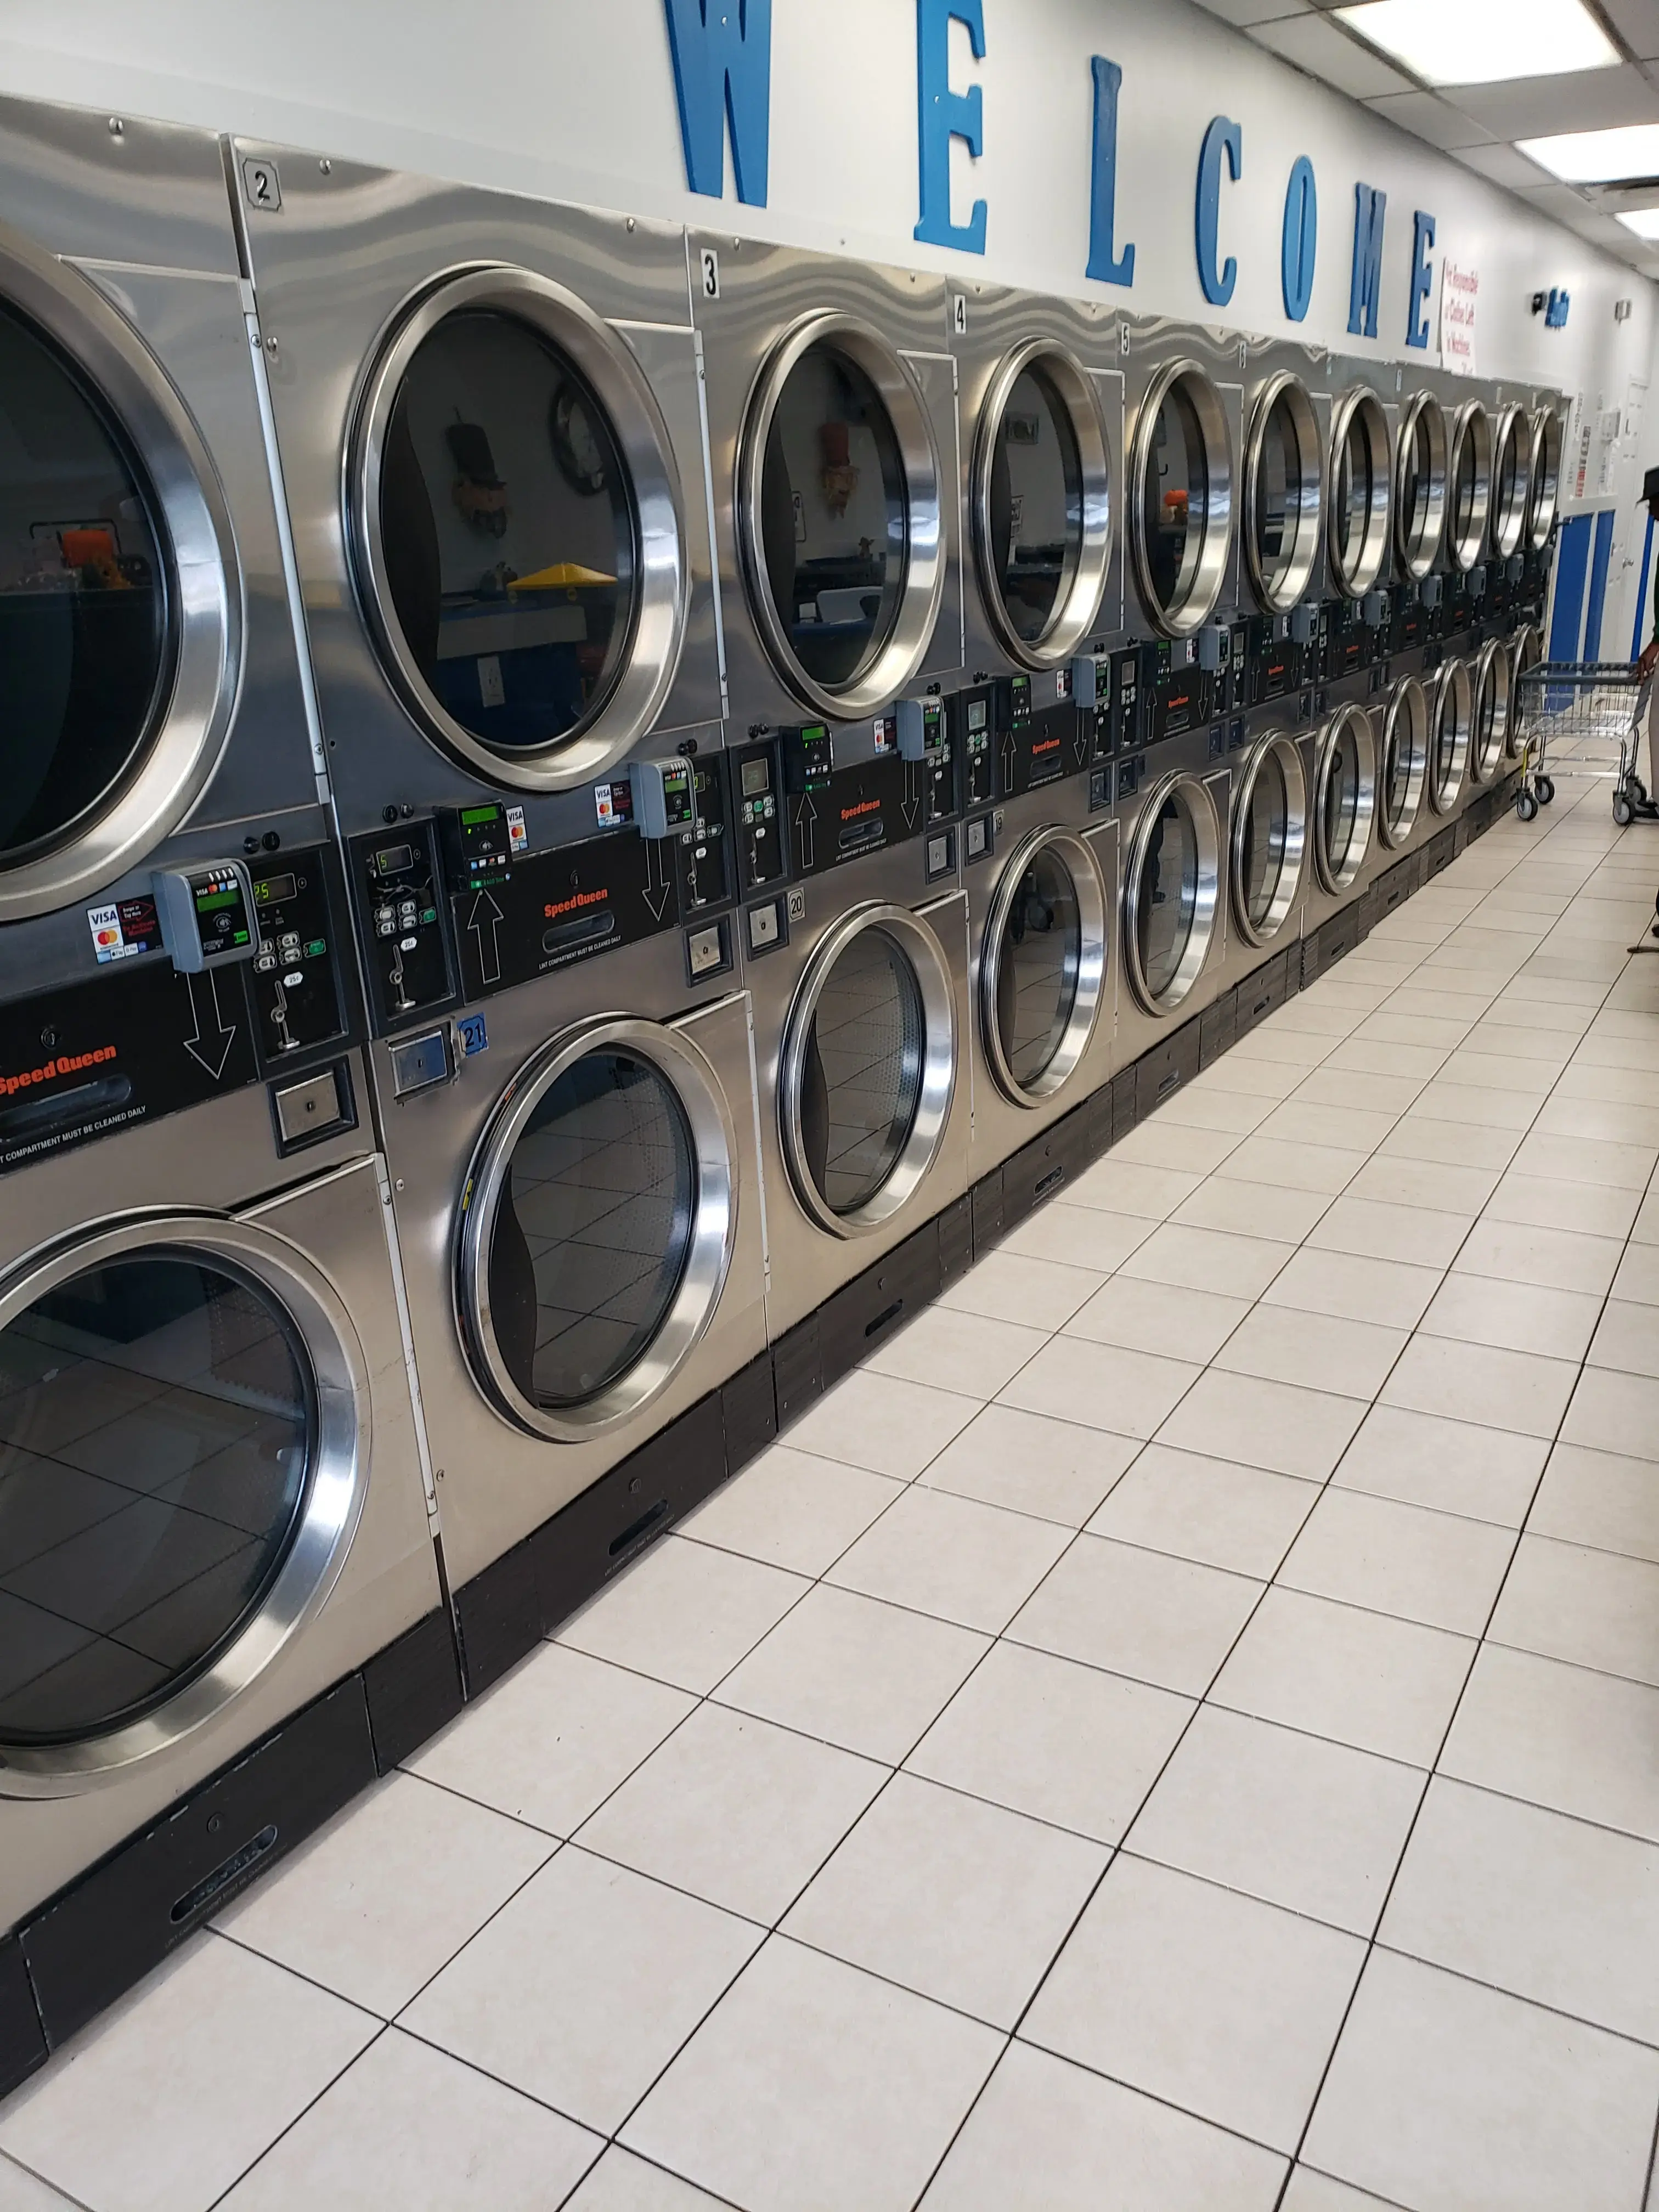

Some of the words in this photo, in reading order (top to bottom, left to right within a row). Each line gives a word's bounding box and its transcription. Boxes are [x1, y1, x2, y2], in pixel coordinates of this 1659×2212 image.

[255, 171, 270, 200] 2
[665, 0, 1435, 348] WELCOME
[704, 254, 716, 295] 3
[957, 300, 964, 330] 4
[1123, 325, 1128, 352] 5
[596, 790, 610, 799] VISA
[507, 811, 523, 822] VISA
[841, 804, 861, 820] Speed
[861, 799, 880, 812] Queen
[996, 817, 1002, 831] 19
[196, 888, 208, 896] VISA
[544, 896, 576, 918] Speed
[577, 889, 608, 906] Queen
[791, 896, 802, 915] 20
[92, 910, 117, 925] VISA
[539, 961, 548, 970] LINT
[549, 951, 577, 966] COMPARTMENT
[577, 946, 588, 956] MUST
[594, 939, 611, 950] CLEANED
[611, 935, 621, 944] DAILY
[464, 1023, 482, 1048] 21
[57, 1045, 117, 1074] Queen
[5, 1135, 61, 1162] COMPARTMENT
[62, 1128, 82, 1142] MUST
[83, 1124, 93, 1134] BE
[94, 1113, 127, 1130] CLEANED
[128, 1105, 146, 1119] DAILY
